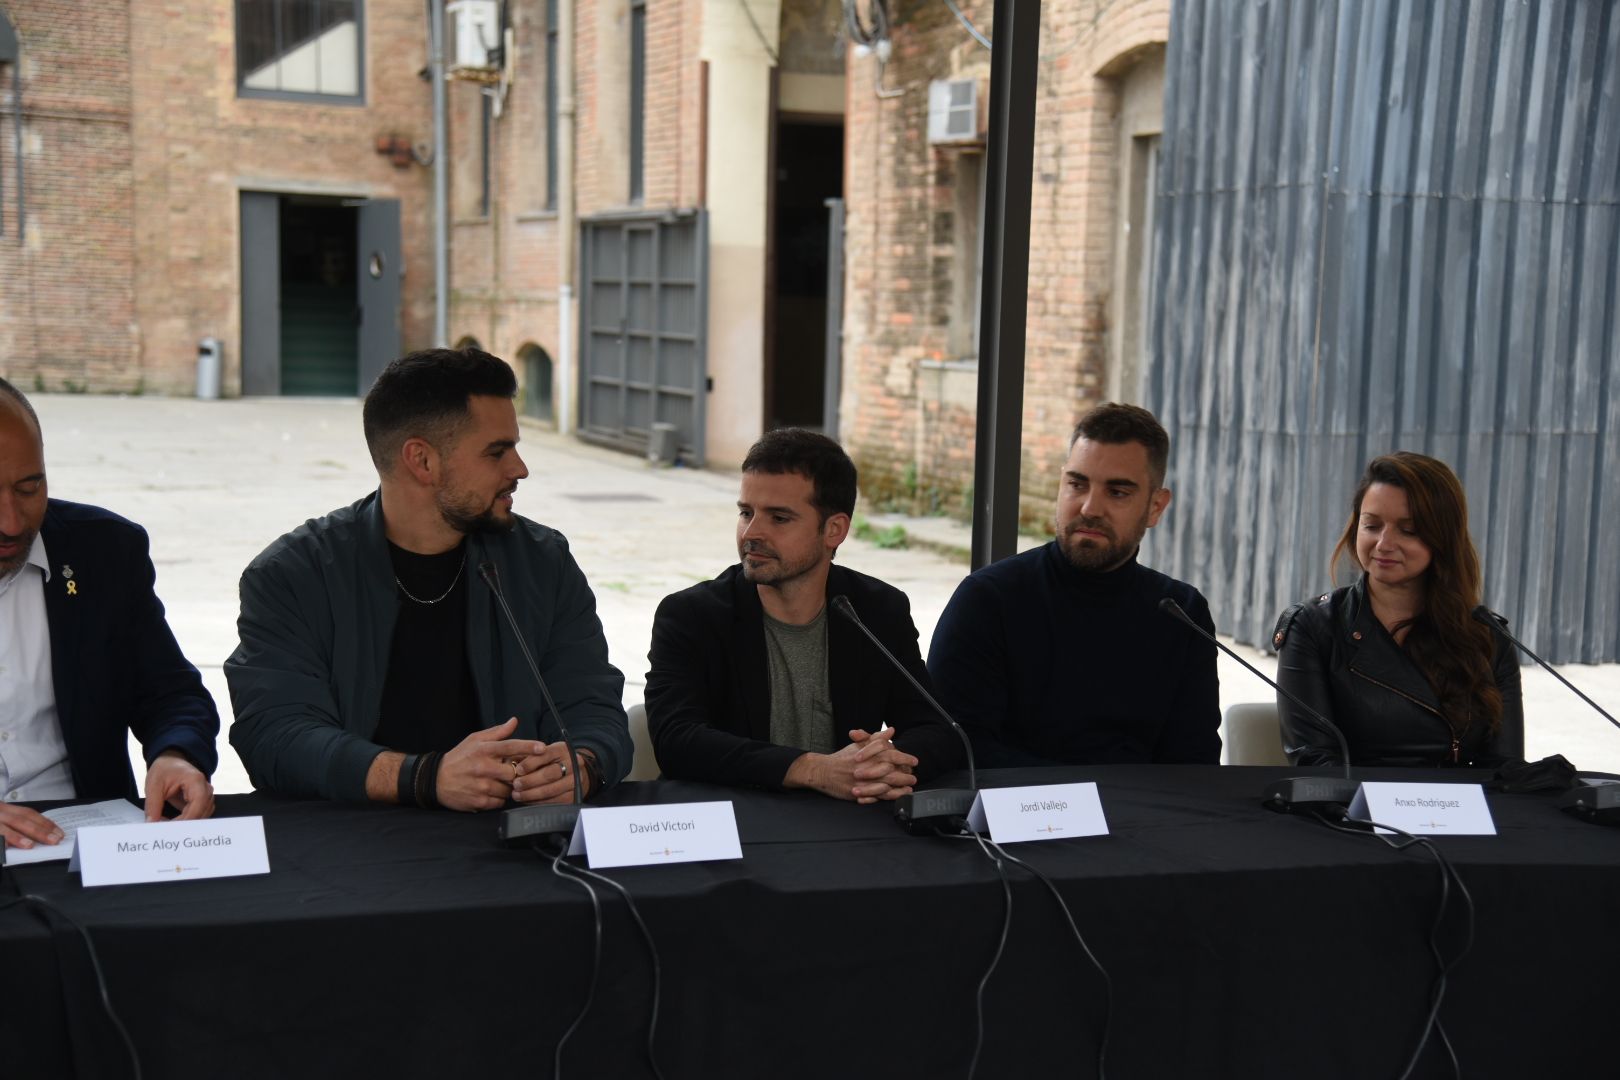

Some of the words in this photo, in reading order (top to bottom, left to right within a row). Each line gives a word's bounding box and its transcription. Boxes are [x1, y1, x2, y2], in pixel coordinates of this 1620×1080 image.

[1020, 801, 1040, 813] Jordi
[1040, 800, 1068, 812] Vallejo
[1394, 797, 1416, 807] Anxo
[629, 821, 660, 834] David
[661, 820, 695, 832] Victori
[117, 841, 149, 853] Marc
[152, 839, 180, 852] Aloy
[183, 835, 232, 848] Guàrdia
